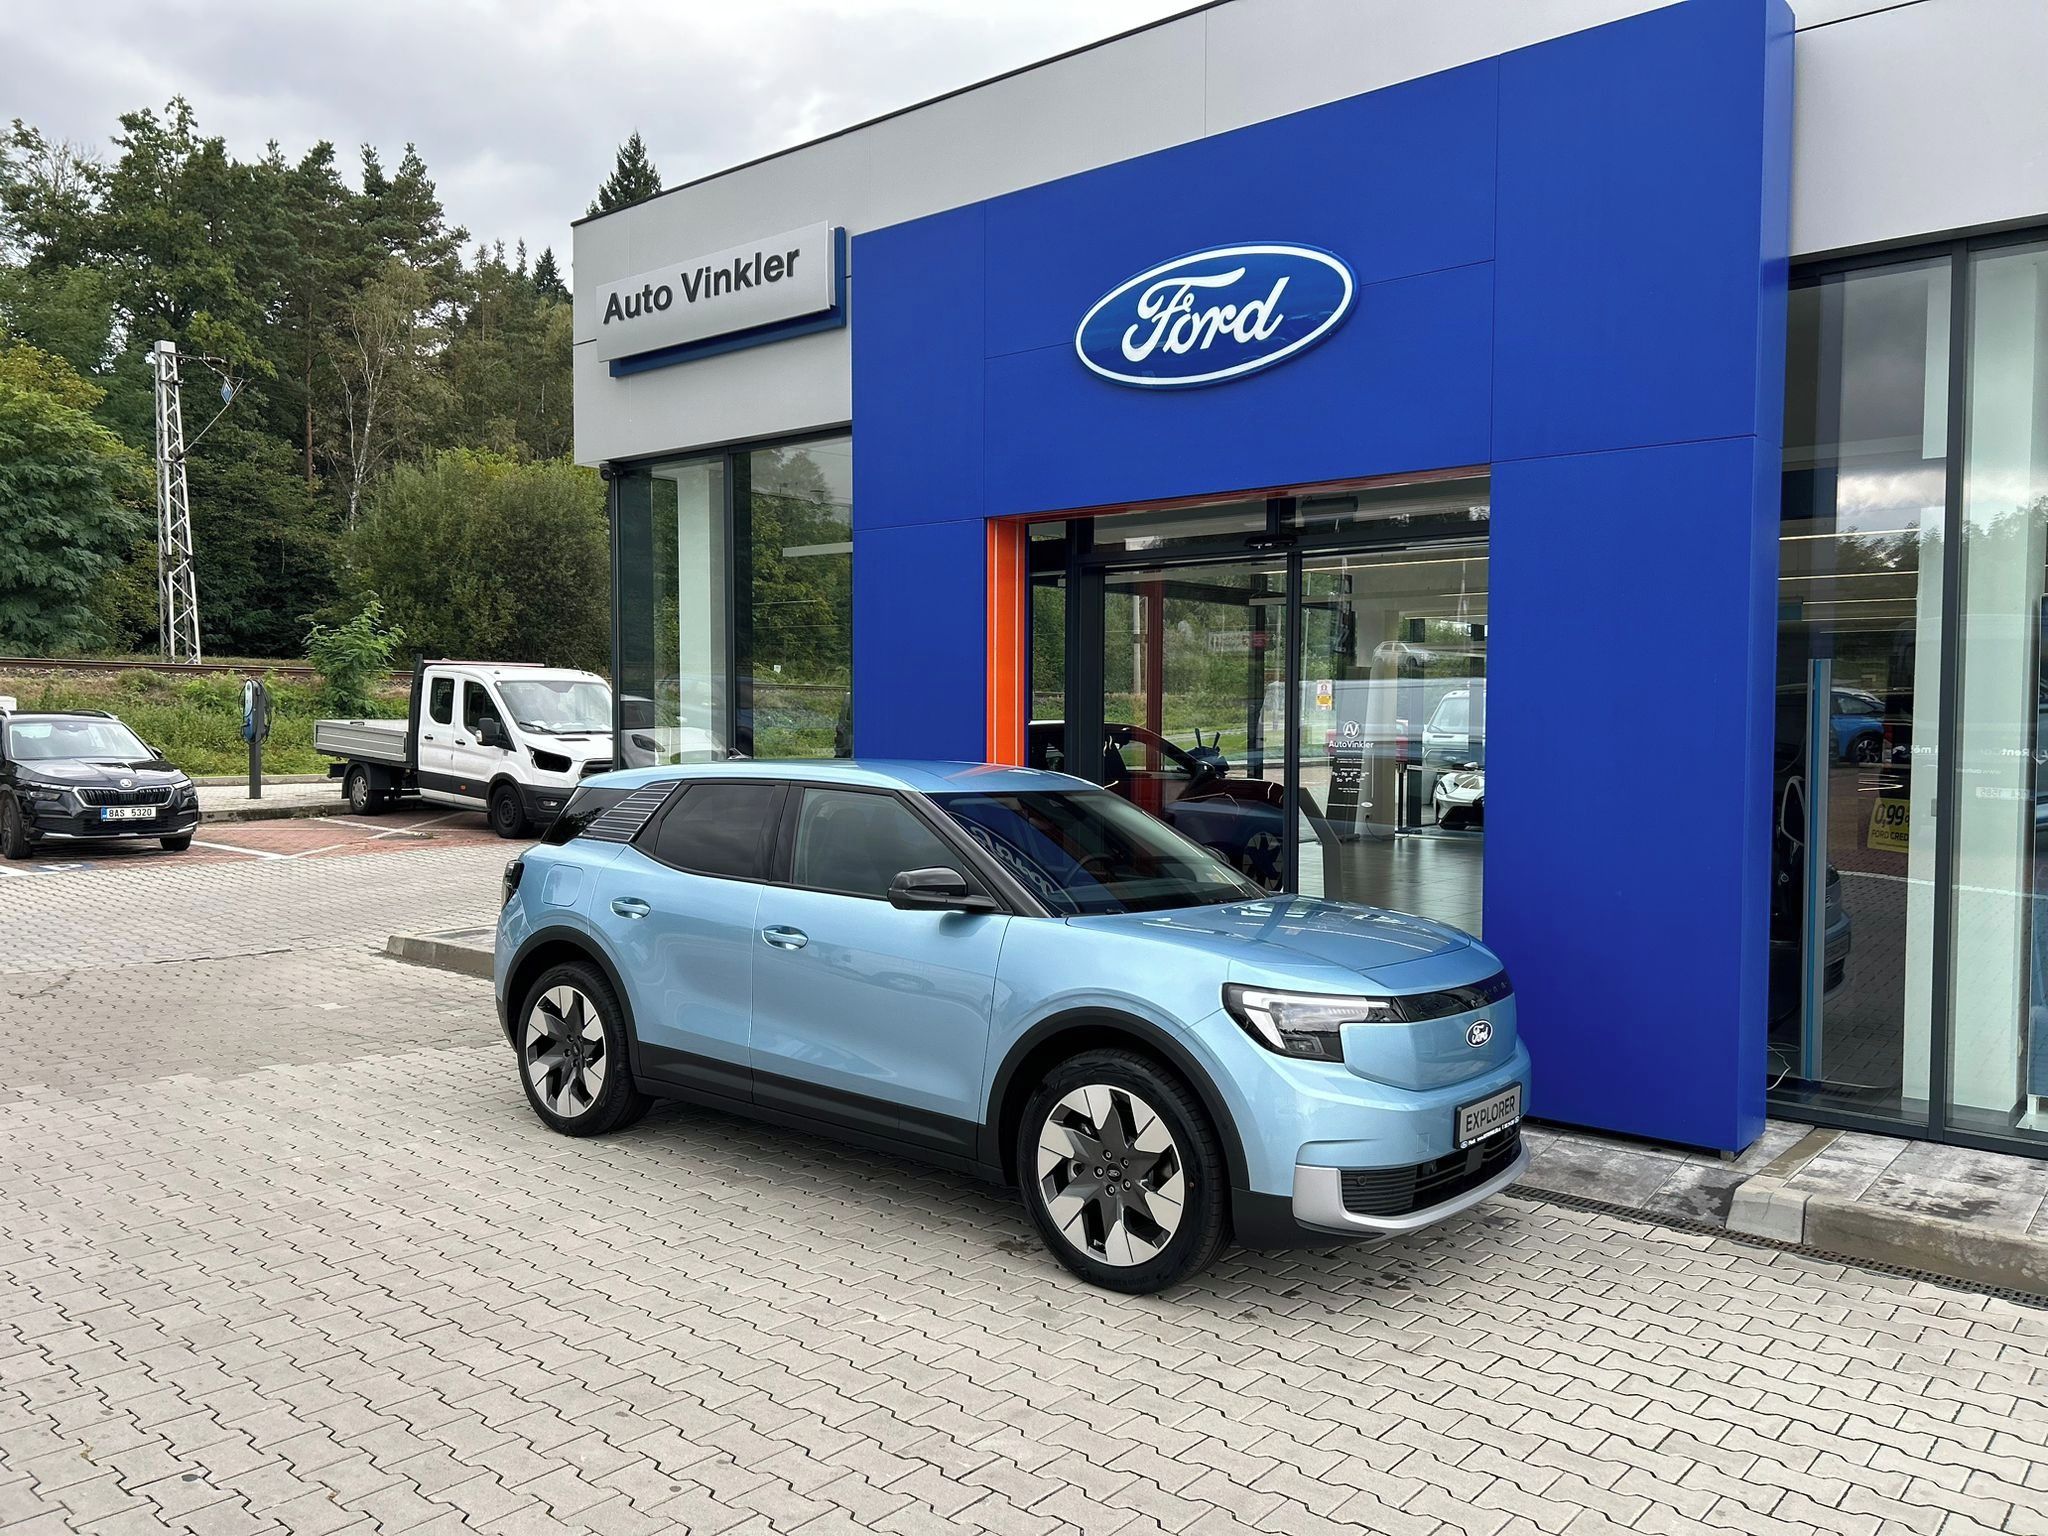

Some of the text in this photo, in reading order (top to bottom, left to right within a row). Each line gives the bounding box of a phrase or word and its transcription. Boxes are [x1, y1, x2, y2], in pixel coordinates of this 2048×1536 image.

[603, 249, 800, 325] Auto Vinkler
[1122, 267, 1290, 362] Ford
[108, 808, 152, 818] 8AS 5320
[1465, 1094, 1515, 1133] EXPLORER
